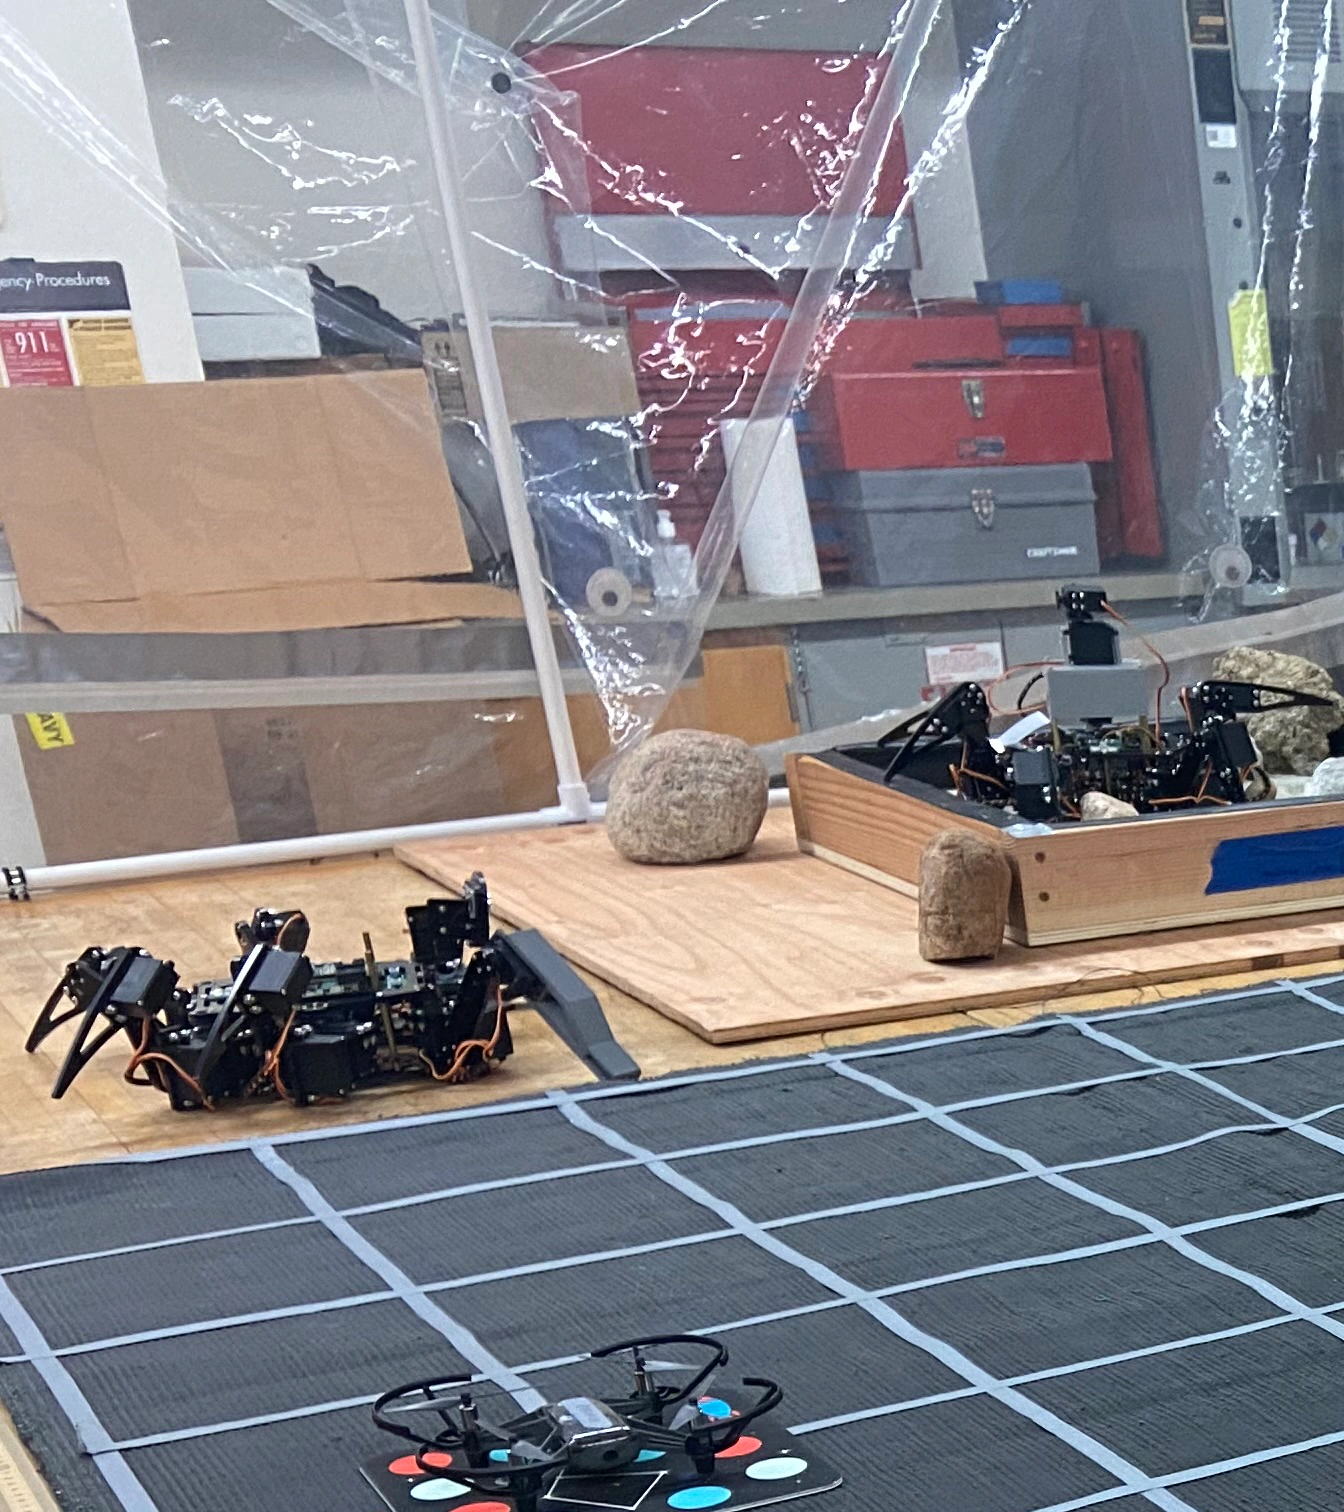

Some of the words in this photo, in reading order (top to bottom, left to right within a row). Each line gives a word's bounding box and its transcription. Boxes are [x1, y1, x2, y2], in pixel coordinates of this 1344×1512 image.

[0, 277, 31, 291] ency
[35, 271, 110, 288] Procedures
[14, 331, 49, 354] 911
